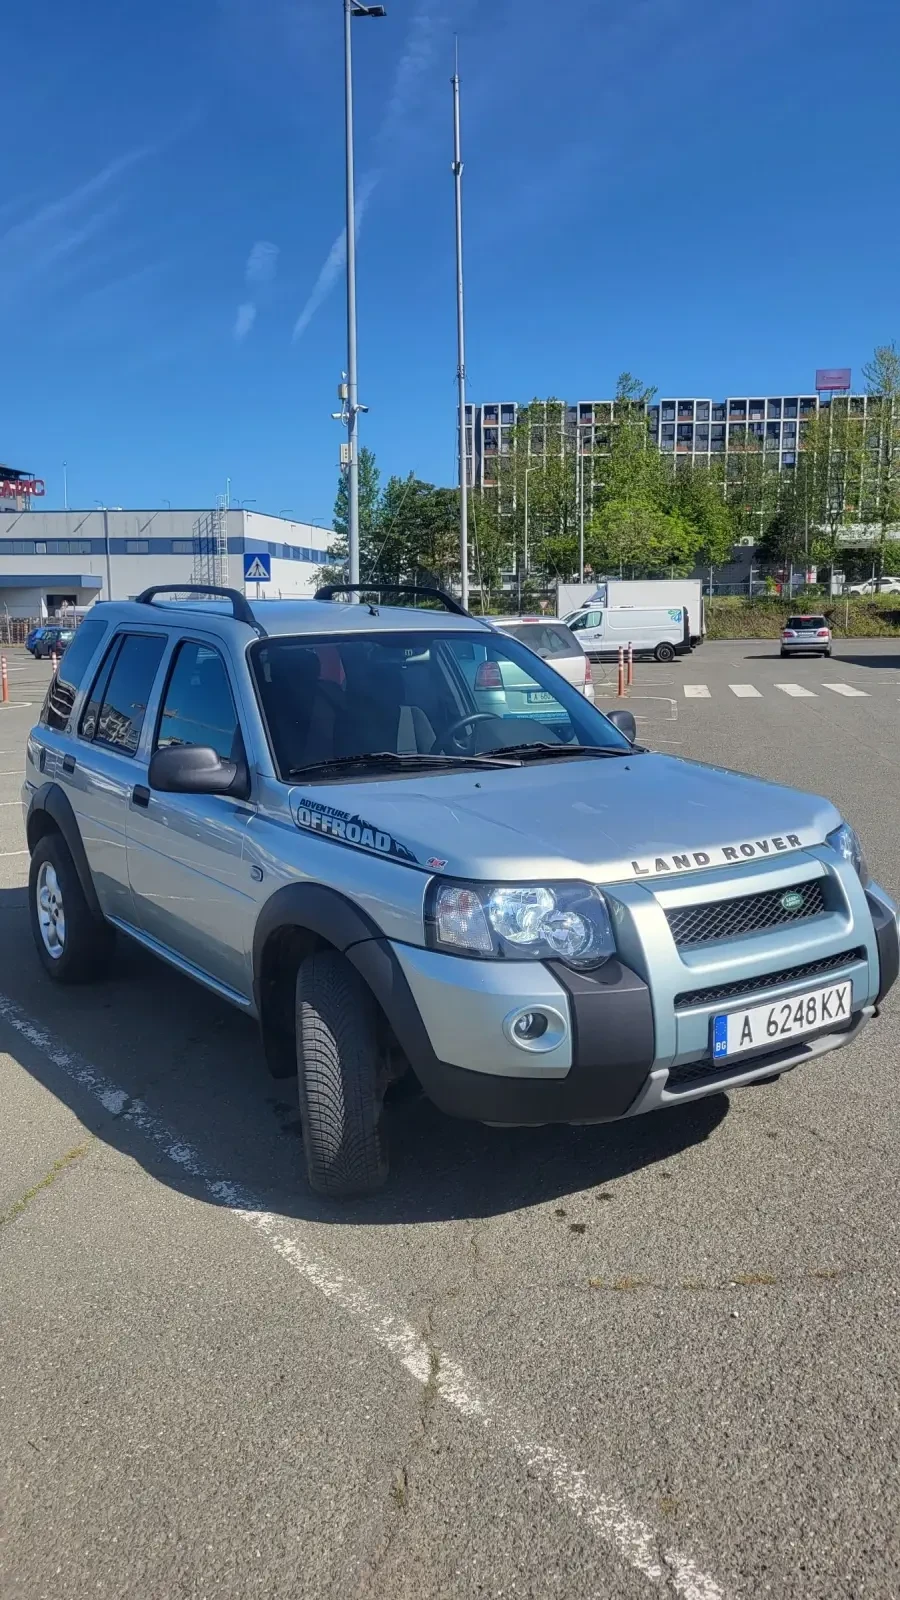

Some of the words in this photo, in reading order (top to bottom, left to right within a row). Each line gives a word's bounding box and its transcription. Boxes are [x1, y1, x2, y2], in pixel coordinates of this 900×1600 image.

[300, 798, 350, 820] ADVENTURE
[298, 806, 391, 852] OFFROAD
[631, 852, 711, 875] LAND
[721, 834, 802, 861] ROVER
[740, 1015, 753, 1046] A
[715, 1041, 727, 1052] BG
